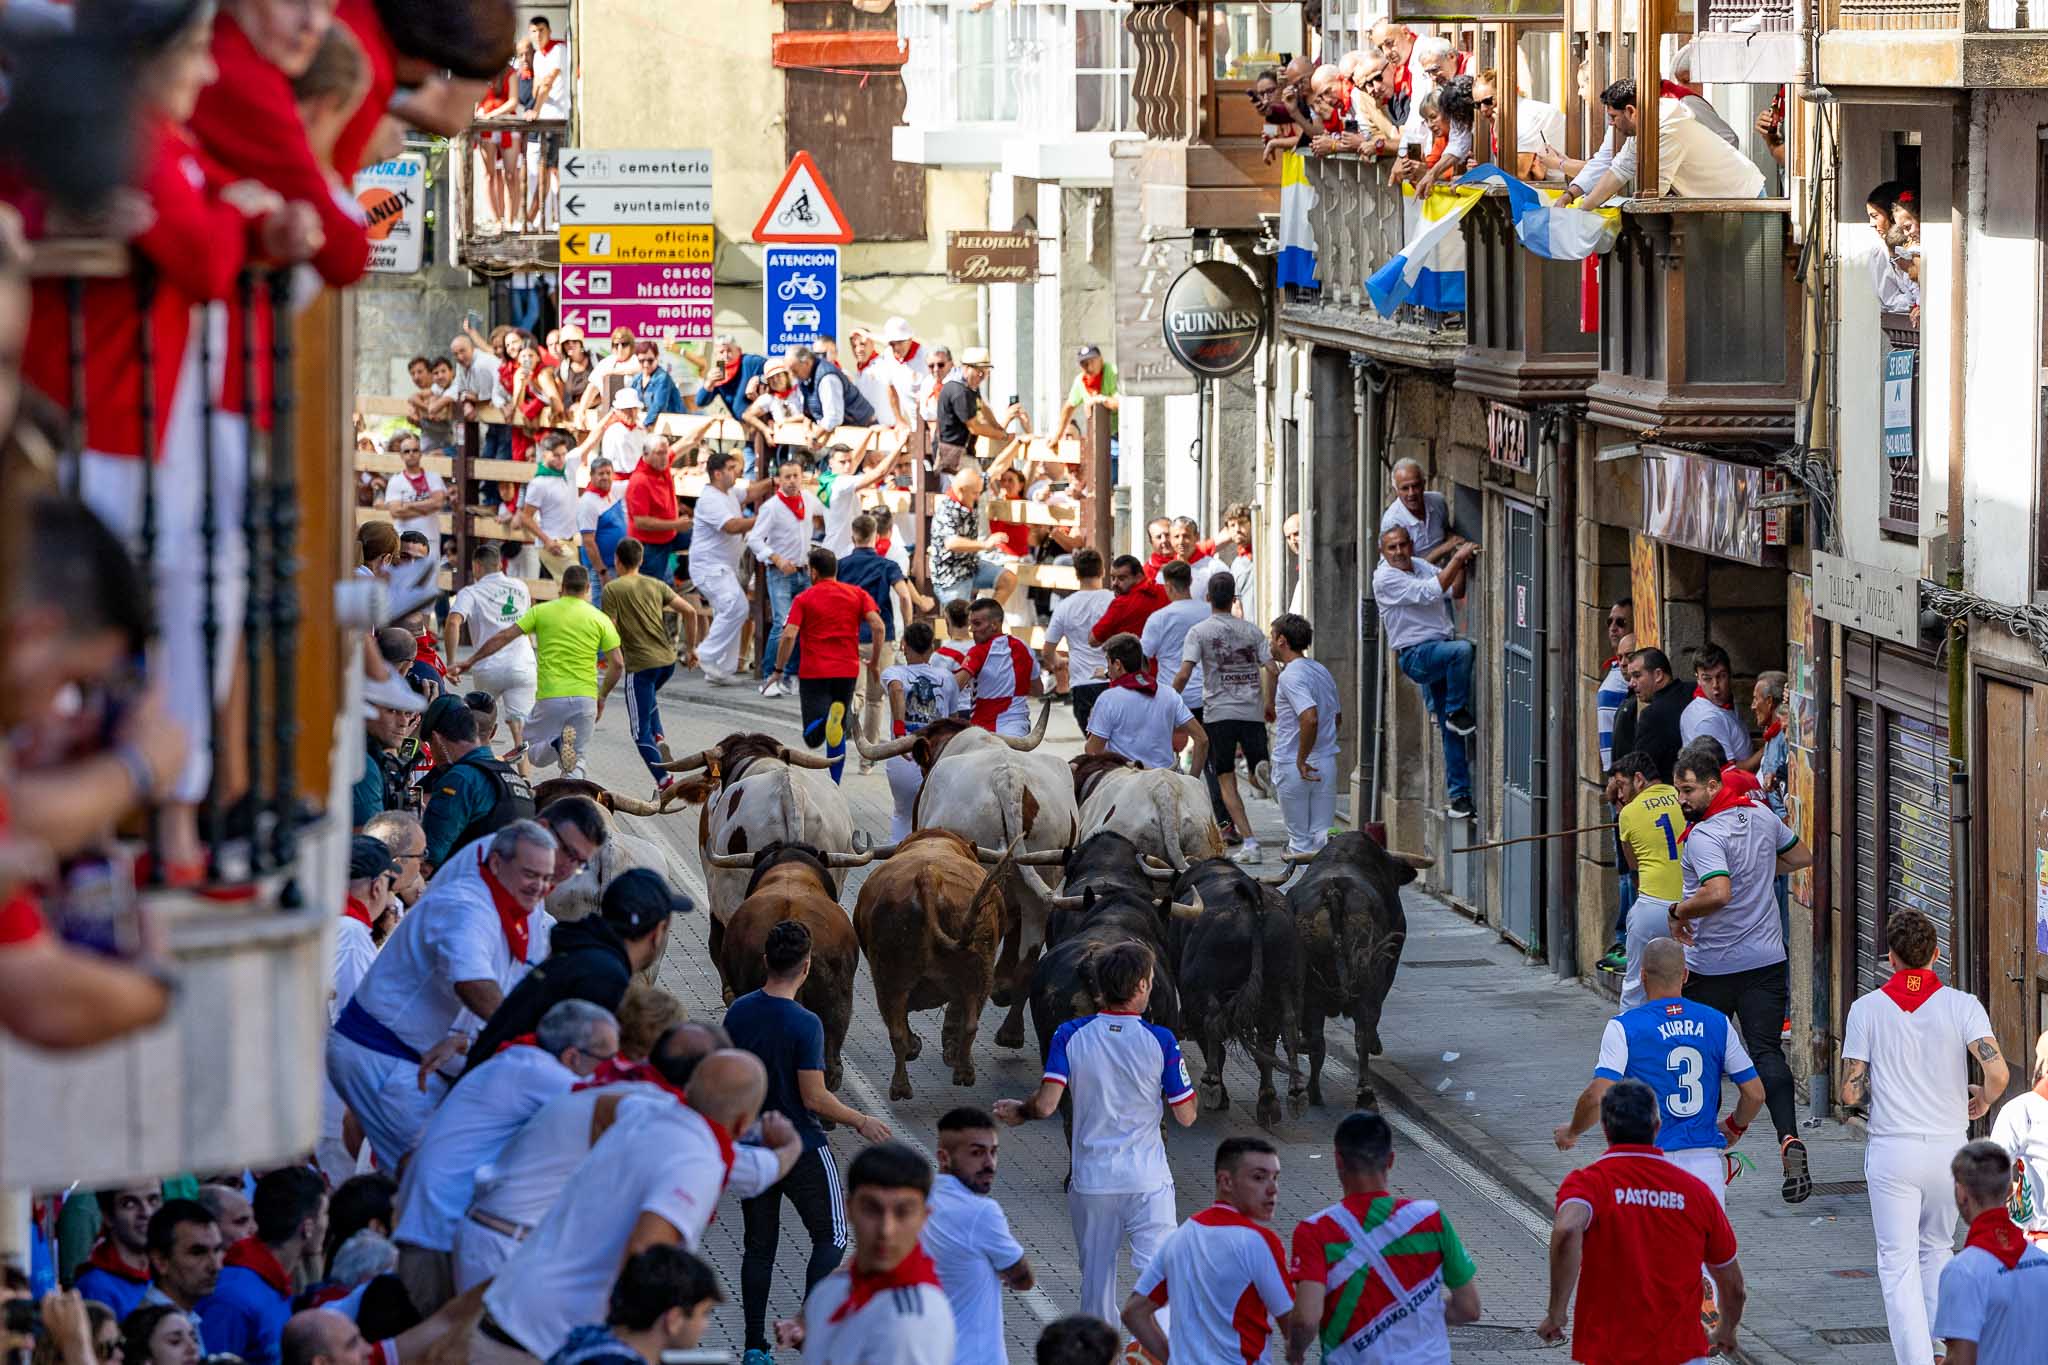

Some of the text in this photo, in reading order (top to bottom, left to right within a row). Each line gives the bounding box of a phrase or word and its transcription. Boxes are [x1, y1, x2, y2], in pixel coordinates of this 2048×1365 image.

[619, 161, 709, 173] cementerio
[614, 200, 710, 214] ayuntamiento
[655, 231, 709, 242] oficina
[617, 246, 710, 258] información
[662, 267, 711, 280] casco
[637, 282, 711, 297] histórico
[657, 304, 711, 318] molino
[1170, 310, 1259, 333] GUINNESS
[1829, 575, 1855, 609] TALLER
[1655, 813, 1679, 861] 1
[1666, 1045, 1704, 1118] 3
[1614, 1186, 1685, 1210] PASTORES
